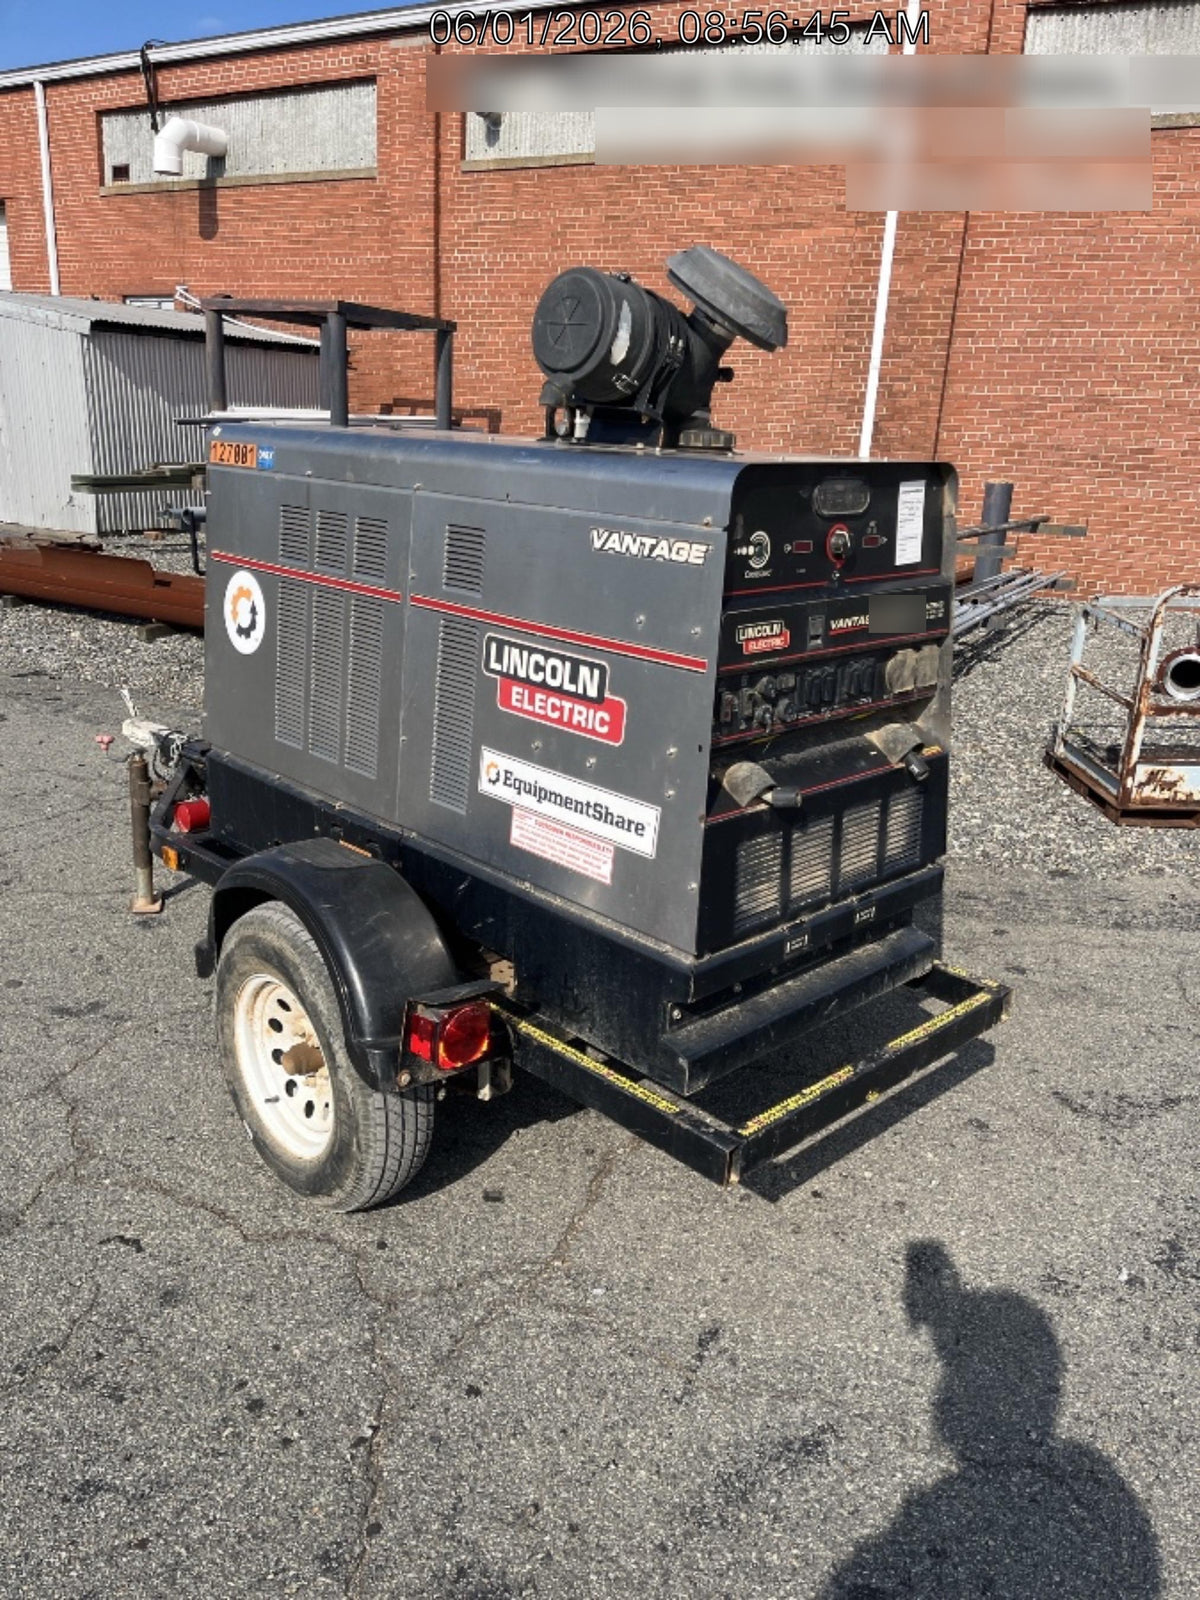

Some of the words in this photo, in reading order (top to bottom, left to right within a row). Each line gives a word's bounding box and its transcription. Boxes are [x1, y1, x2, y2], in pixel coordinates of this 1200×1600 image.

[590, 528, 708, 565] VANTAGE
[738, 623, 782, 640] LINCOLN
[748, 636, 785, 651] ELECTRIC
[489, 642, 600, 698] LINCOLN
[511, 686, 610, 734] ELECTRIC
[502, 770, 646, 837] EquipmentShare
